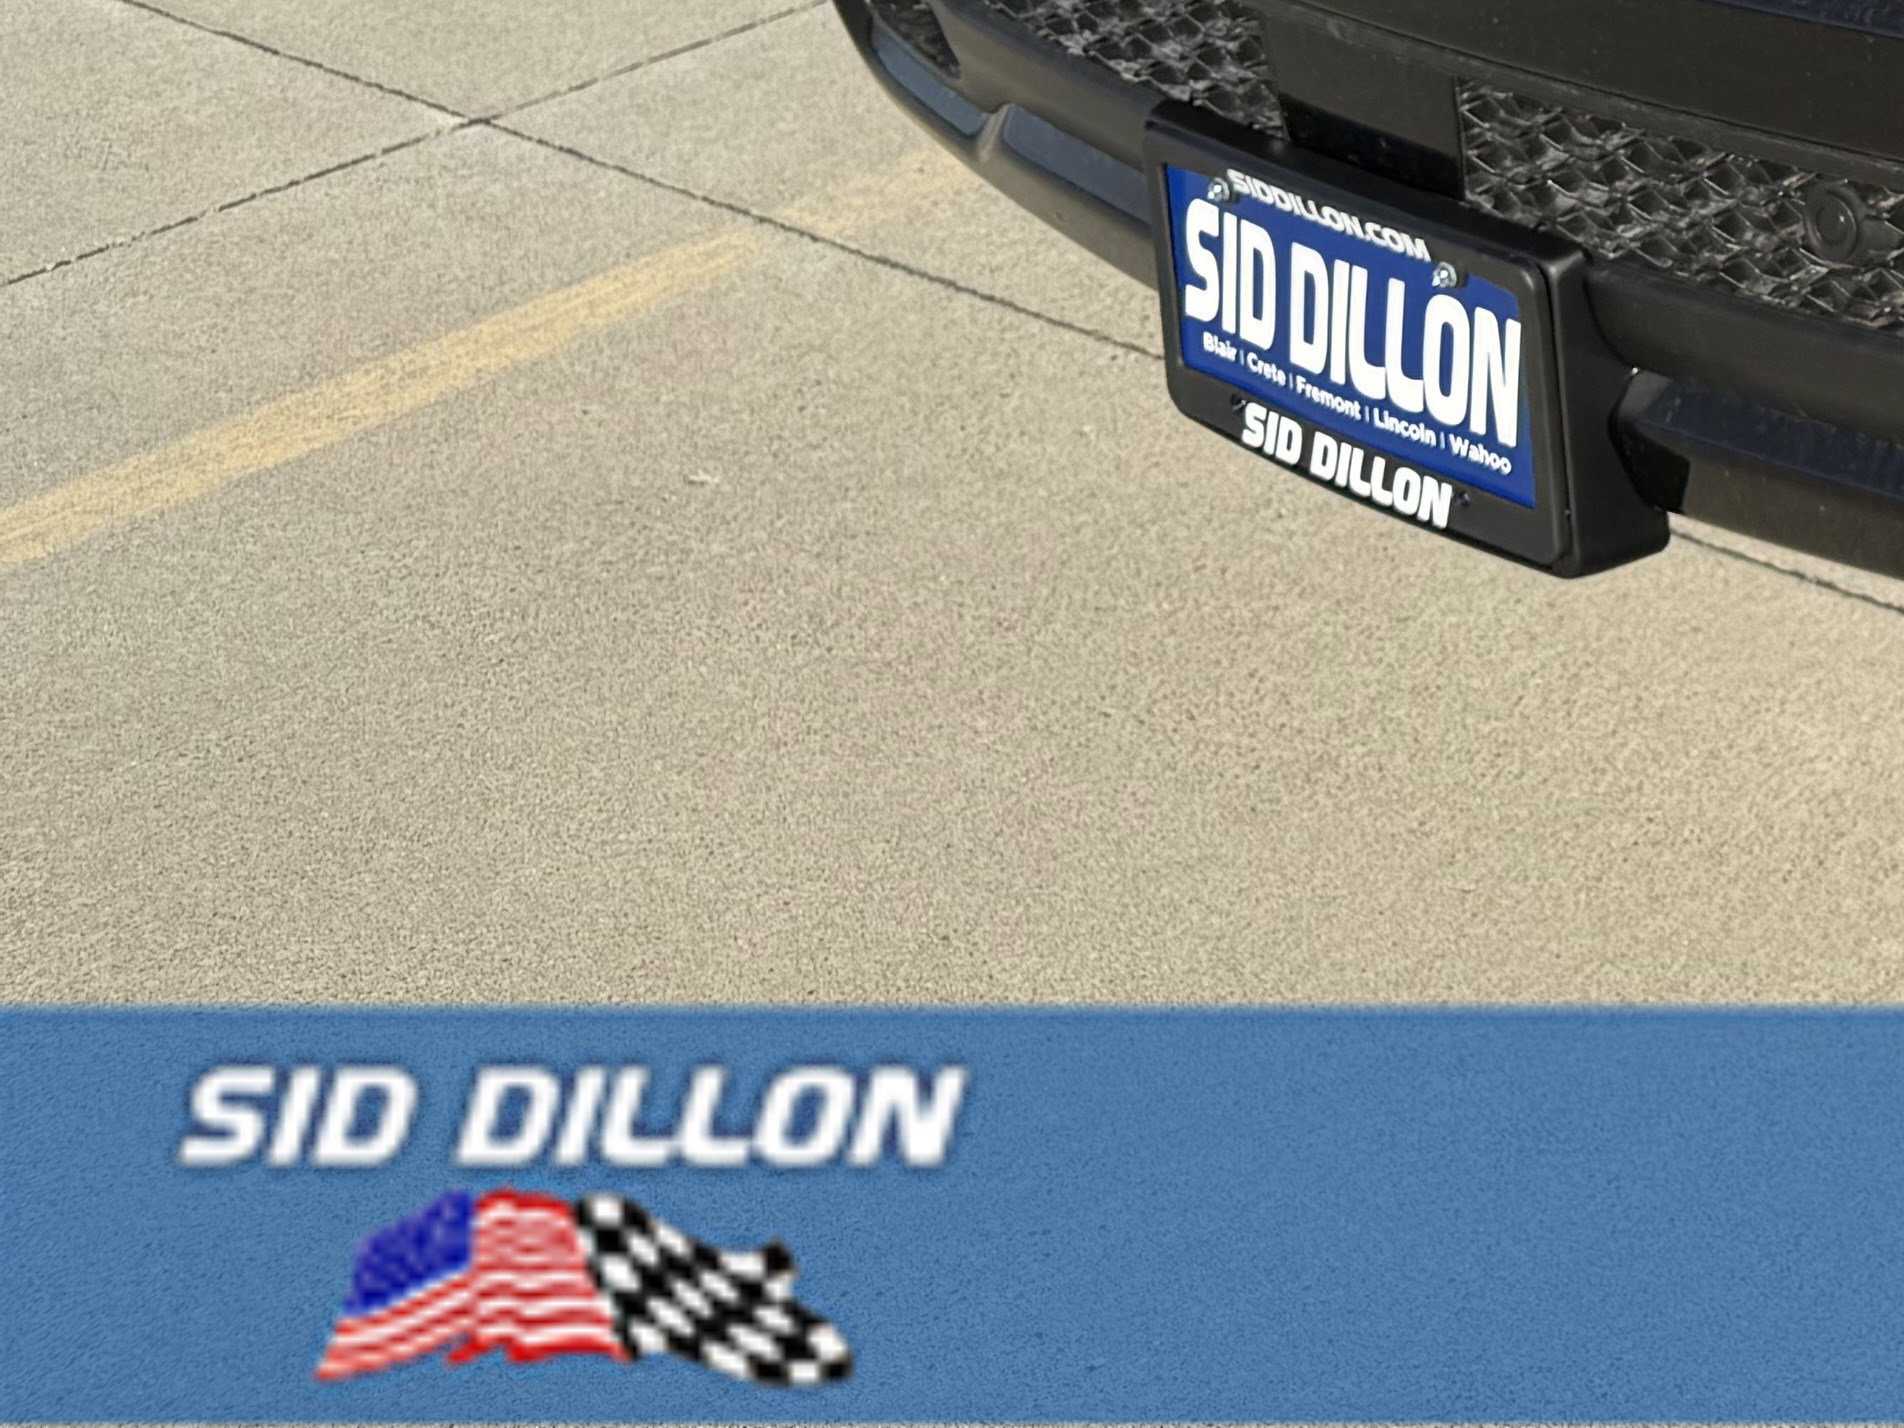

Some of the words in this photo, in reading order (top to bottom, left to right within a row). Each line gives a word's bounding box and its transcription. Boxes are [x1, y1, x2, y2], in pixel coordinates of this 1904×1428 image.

[1226, 168, 1432, 262] SIDDILLON.COM
[1184, 198, 1278, 351] SID
[1289, 241, 1522, 448] DILLON
[1202, 331, 1237, 364] Blair
[1246, 351, 1287, 387] Crete
[1295, 375, 1362, 420] Fremont
[1373, 407, 1437, 447] Lincoln
[1449, 433, 1513, 475] Wahoo
[1241, 402, 1303, 466] SID
[1309, 431, 1453, 530] DILLON
